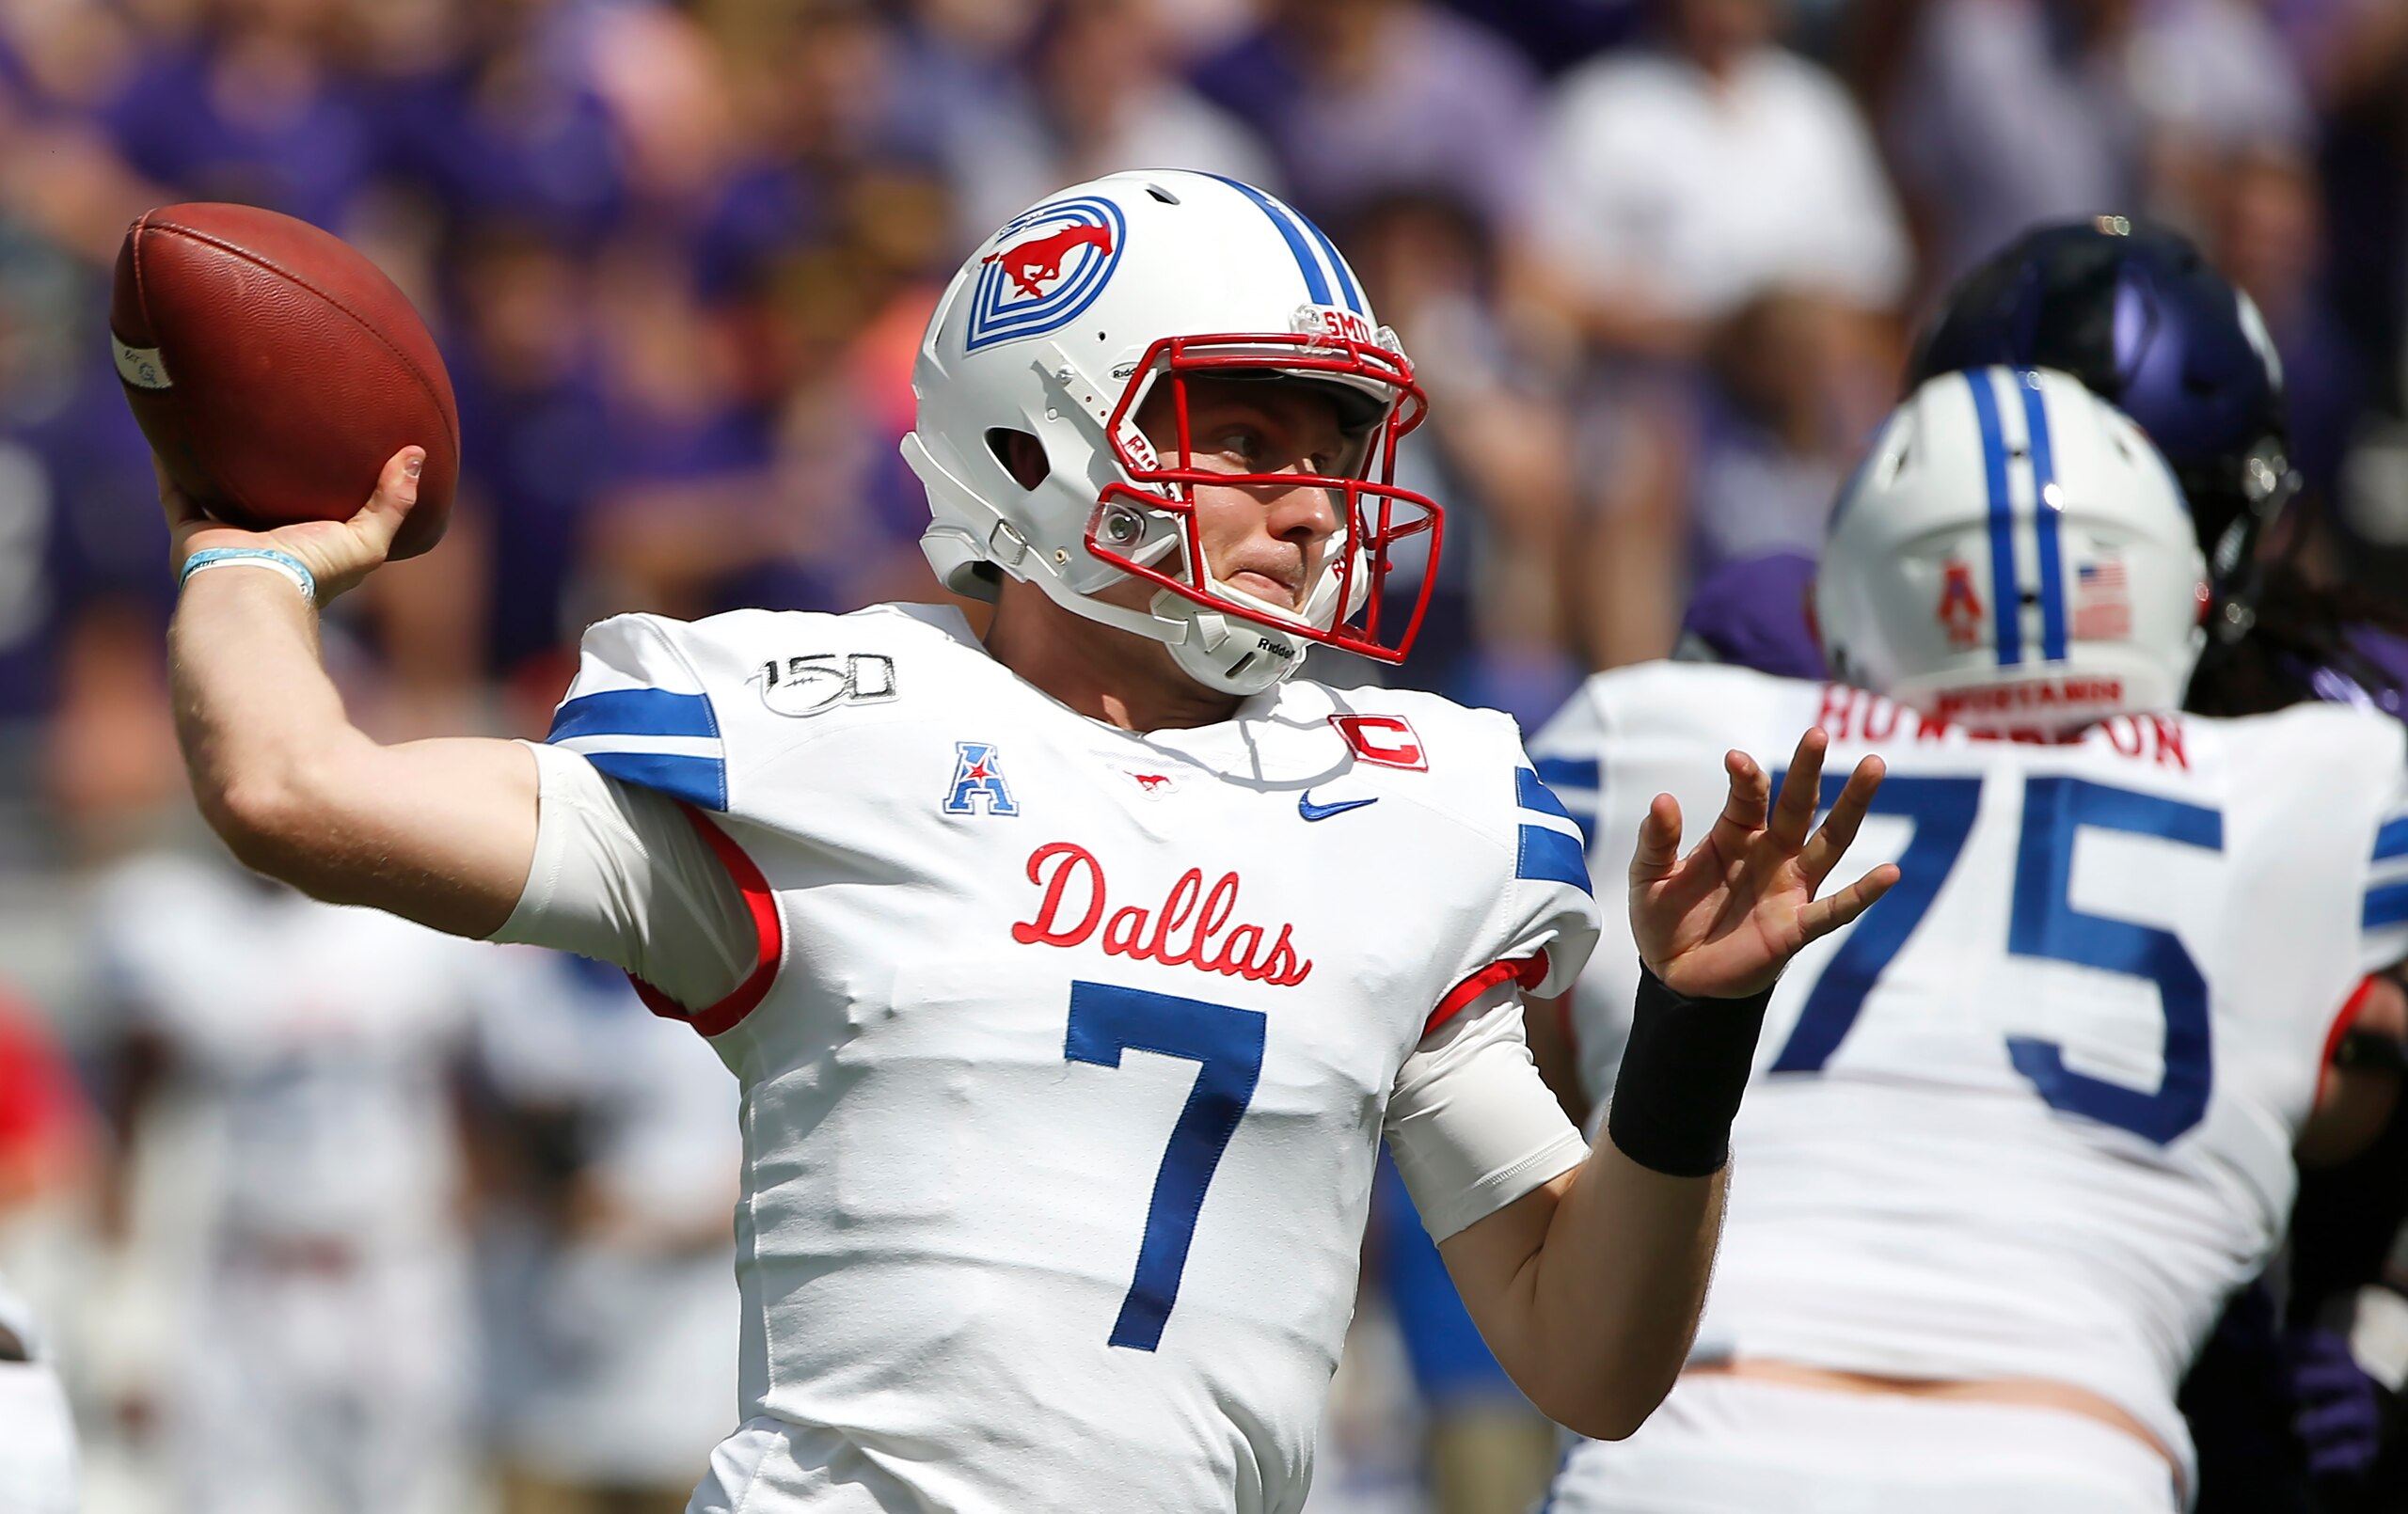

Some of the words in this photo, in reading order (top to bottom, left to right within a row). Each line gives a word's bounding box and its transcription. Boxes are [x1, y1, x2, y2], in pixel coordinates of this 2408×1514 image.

[1323, 311, 1371, 345] SMU
[1339, 717, 1421, 765] C
[1012, 842, 1312, 986] Dallas
[1766, 769, 2225, 1145] 75
[1064, 980, 1266, 1352] 7
